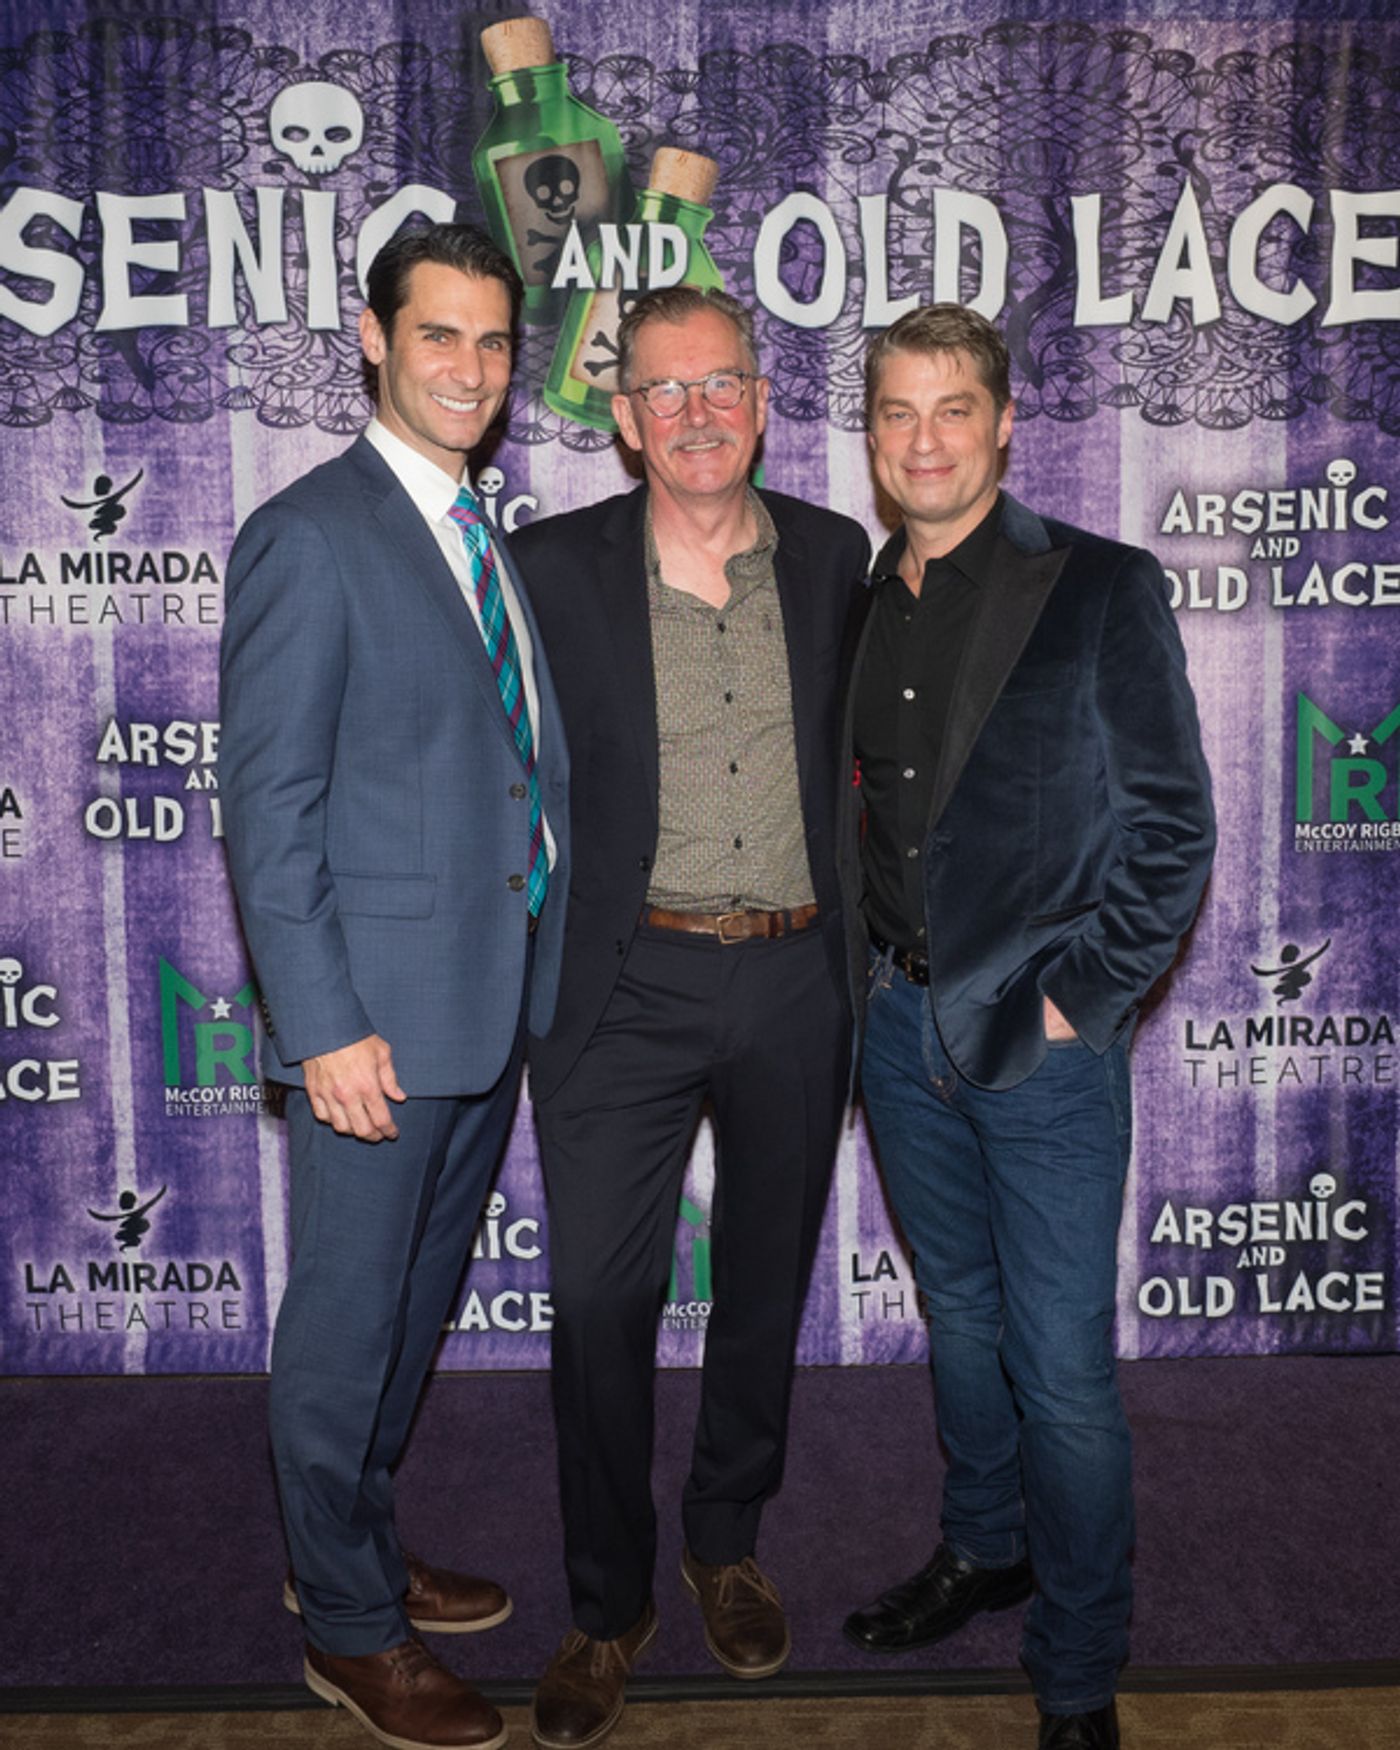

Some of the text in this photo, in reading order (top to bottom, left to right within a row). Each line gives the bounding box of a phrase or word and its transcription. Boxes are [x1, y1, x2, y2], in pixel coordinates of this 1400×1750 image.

[0, 176, 1400, 337] SENIC AND OLD LACE
[1161, 486, 1389, 536] ARSENIC
[1250, 537, 1300, 559] AND
[60, 552, 218, 585] MIRADA
[1271, 561, 1400, 606] LACE
[0, 594, 219, 624] THEATRE
[97, 718, 221, 766] ARSE
[184, 769, 218, 790] AN
[85, 796, 184, 841] OLD
[1295, 821, 1400, 839] McCOY RIGB
[1185, 1016, 1394, 1050] LA MIRADA
[0, 1059, 80, 1102] CE
[1184, 1054, 1393, 1088] THEATRE
[165, 1087, 225, 1103] McCOY
[1151, 1200, 1368, 1248] ARSENIC
[852, 1250, 898, 1283] LA
[1236, 1246, 1286, 1268] AND
[25, 1262, 241, 1294] LA MIRADA
[1138, 1271, 1385, 1318] OLD LACE
[26, 1301, 242, 1331] THEATRE
[448, 1288, 555, 1332] ACE
[662, 1302, 713, 1318] McCO
